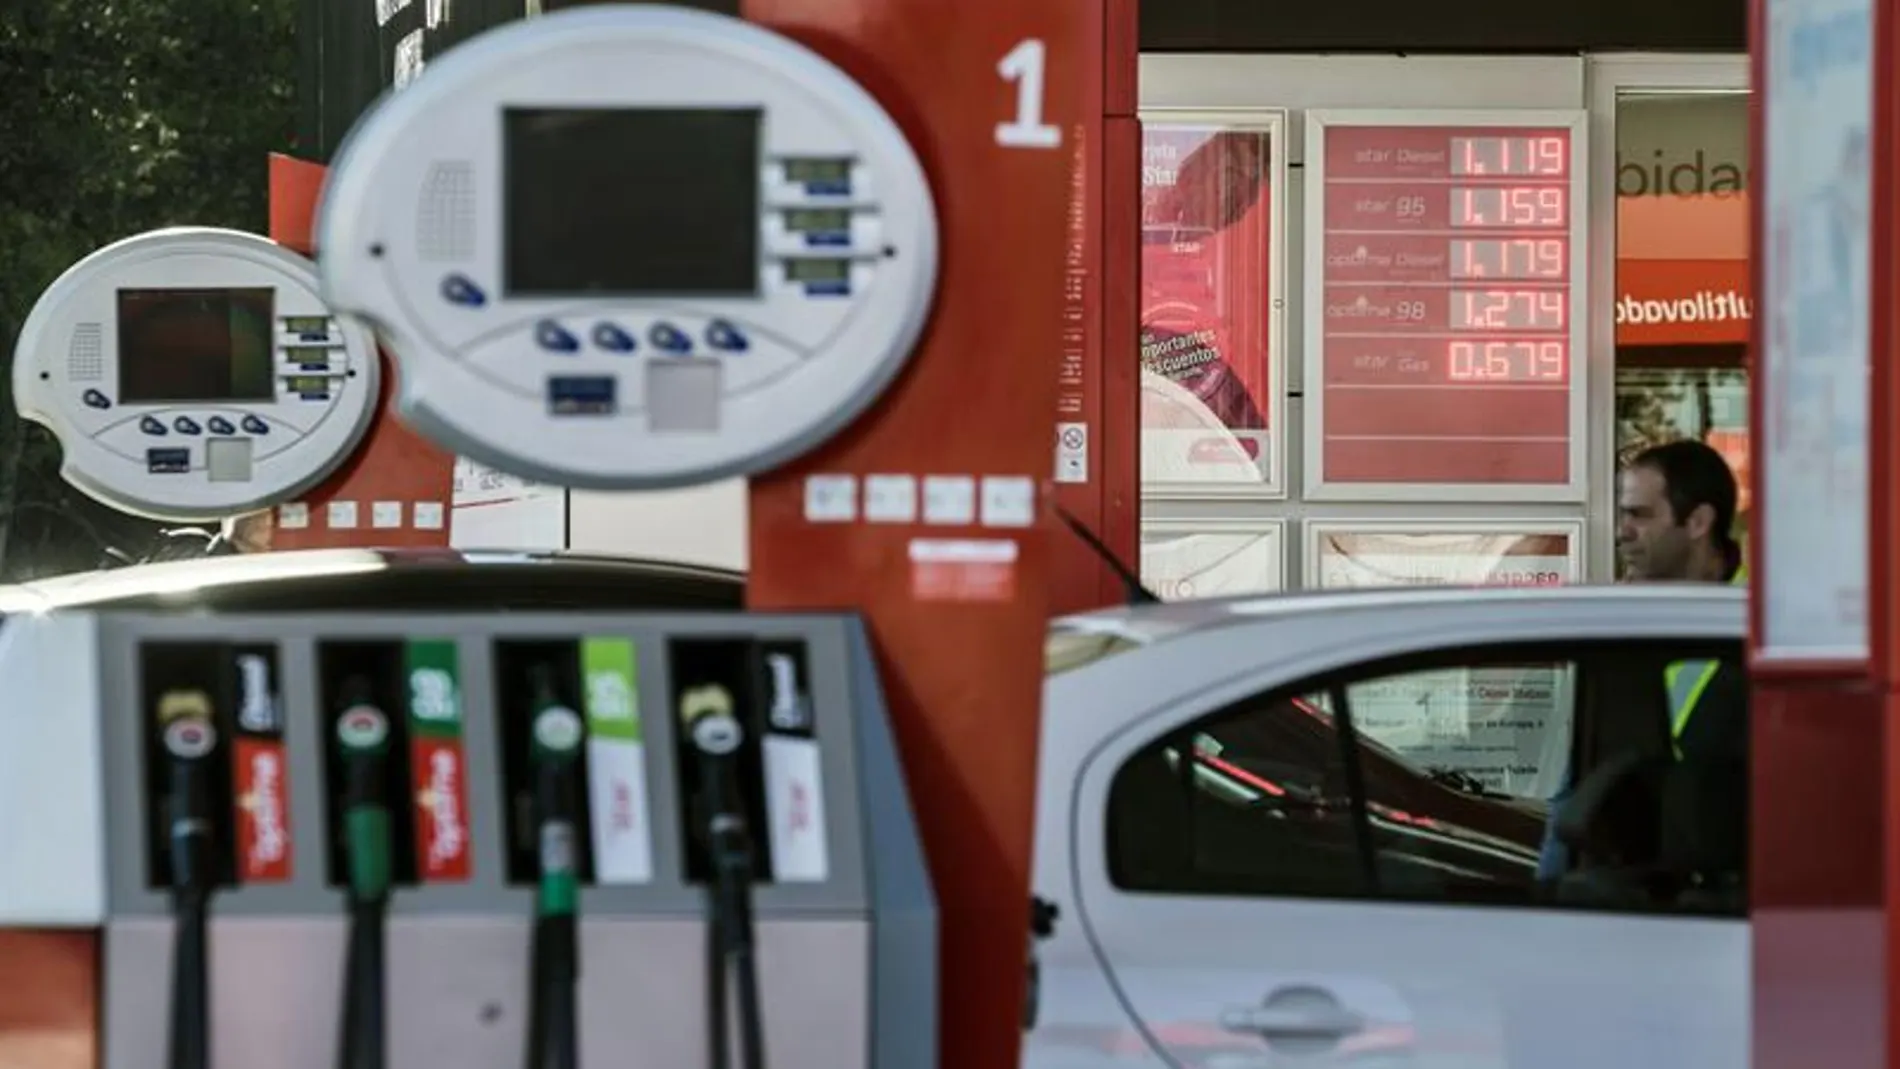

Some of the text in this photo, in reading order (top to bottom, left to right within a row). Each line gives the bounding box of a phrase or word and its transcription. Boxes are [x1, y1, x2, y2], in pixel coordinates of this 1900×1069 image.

[994, 38, 1063, 148] 1
[1464, 137, 1563, 174] 1.119
[1464, 187, 1563, 225] 1.159
[1464, 238, 1563, 276] 1.179
[1397, 301, 1426, 320] 98
[1464, 290, 1563, 328] 1.274
[1449, 341, 1563, 378] 0.679
